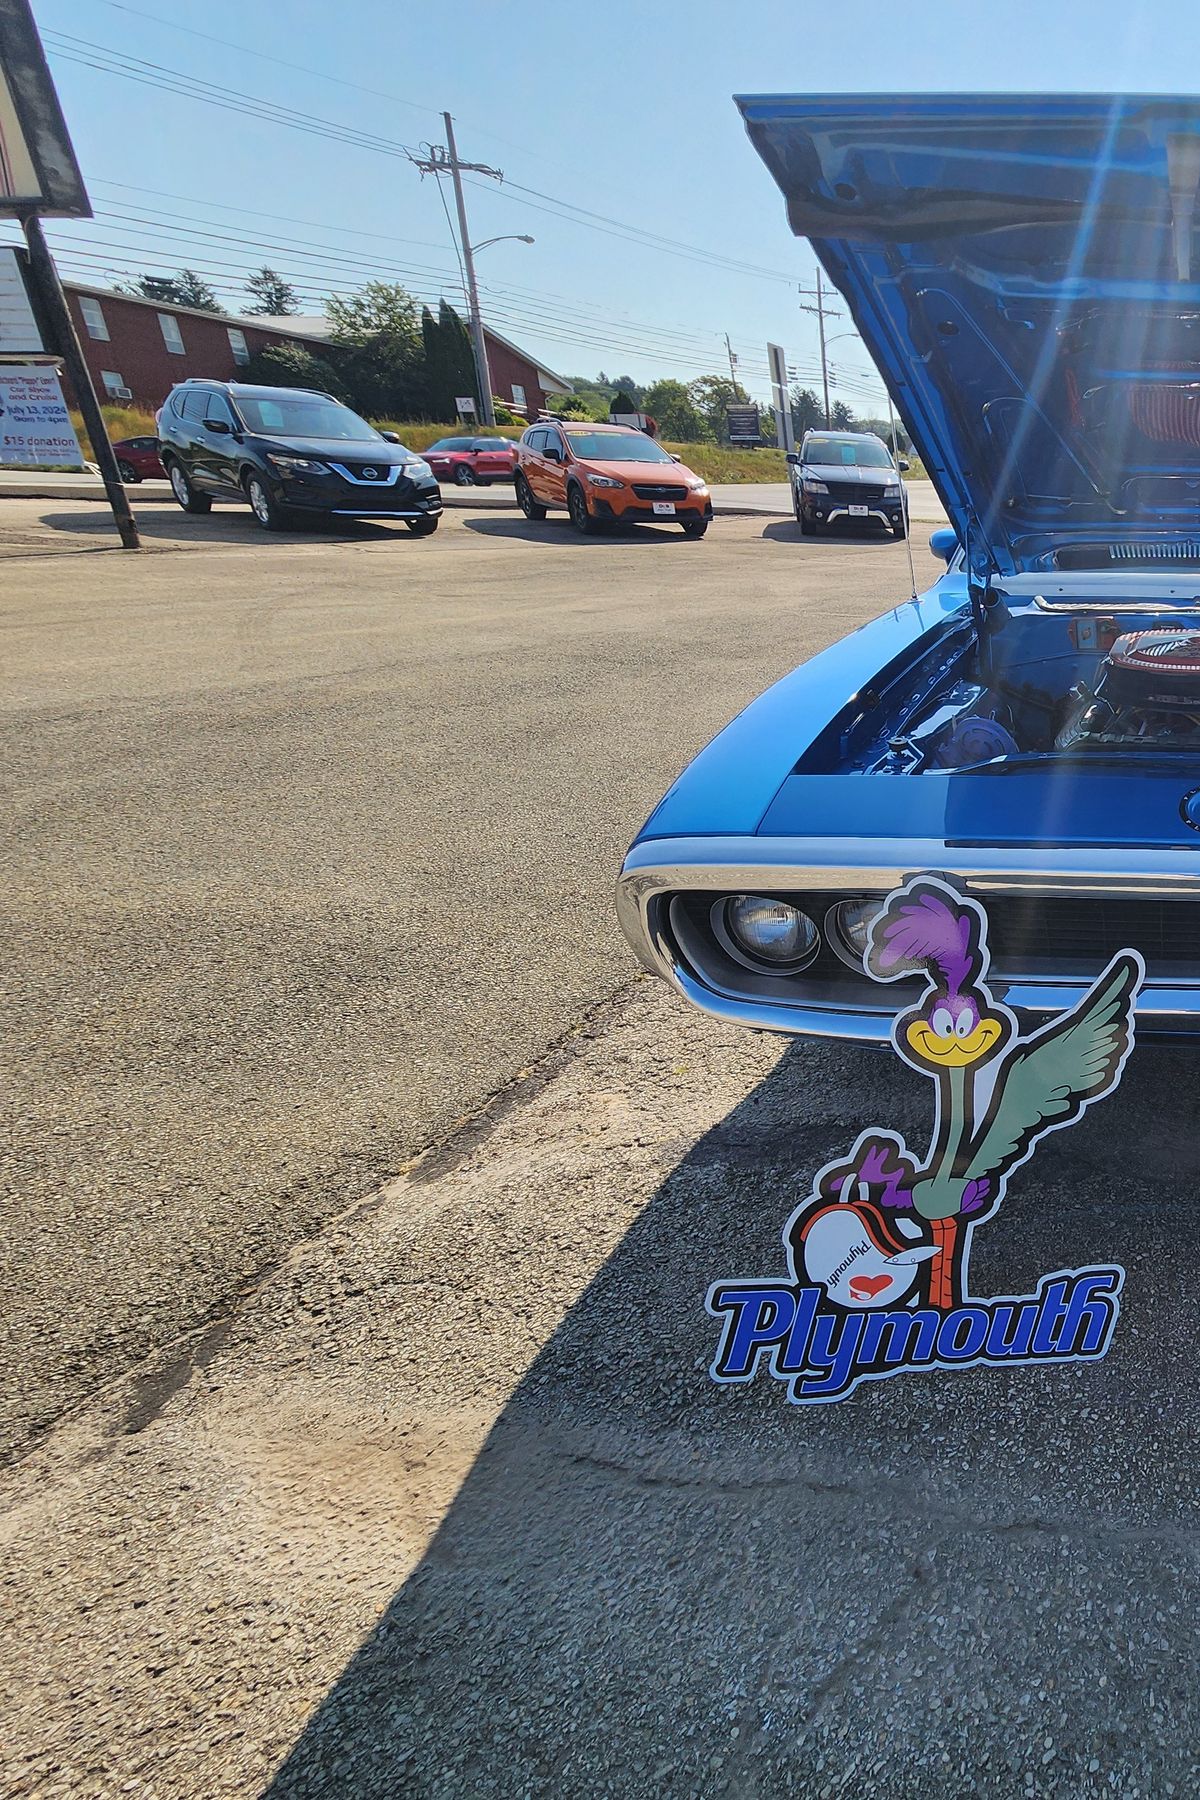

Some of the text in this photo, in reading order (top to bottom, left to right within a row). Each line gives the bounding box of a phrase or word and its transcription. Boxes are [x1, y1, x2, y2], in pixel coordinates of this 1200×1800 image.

[7, 405, 25, 416] July
[4, 436, 75, 446] $15 donation
[827, 1240, 872, 1288] Plymouth
[718, 1275, 1115, 1394] Plymouth
